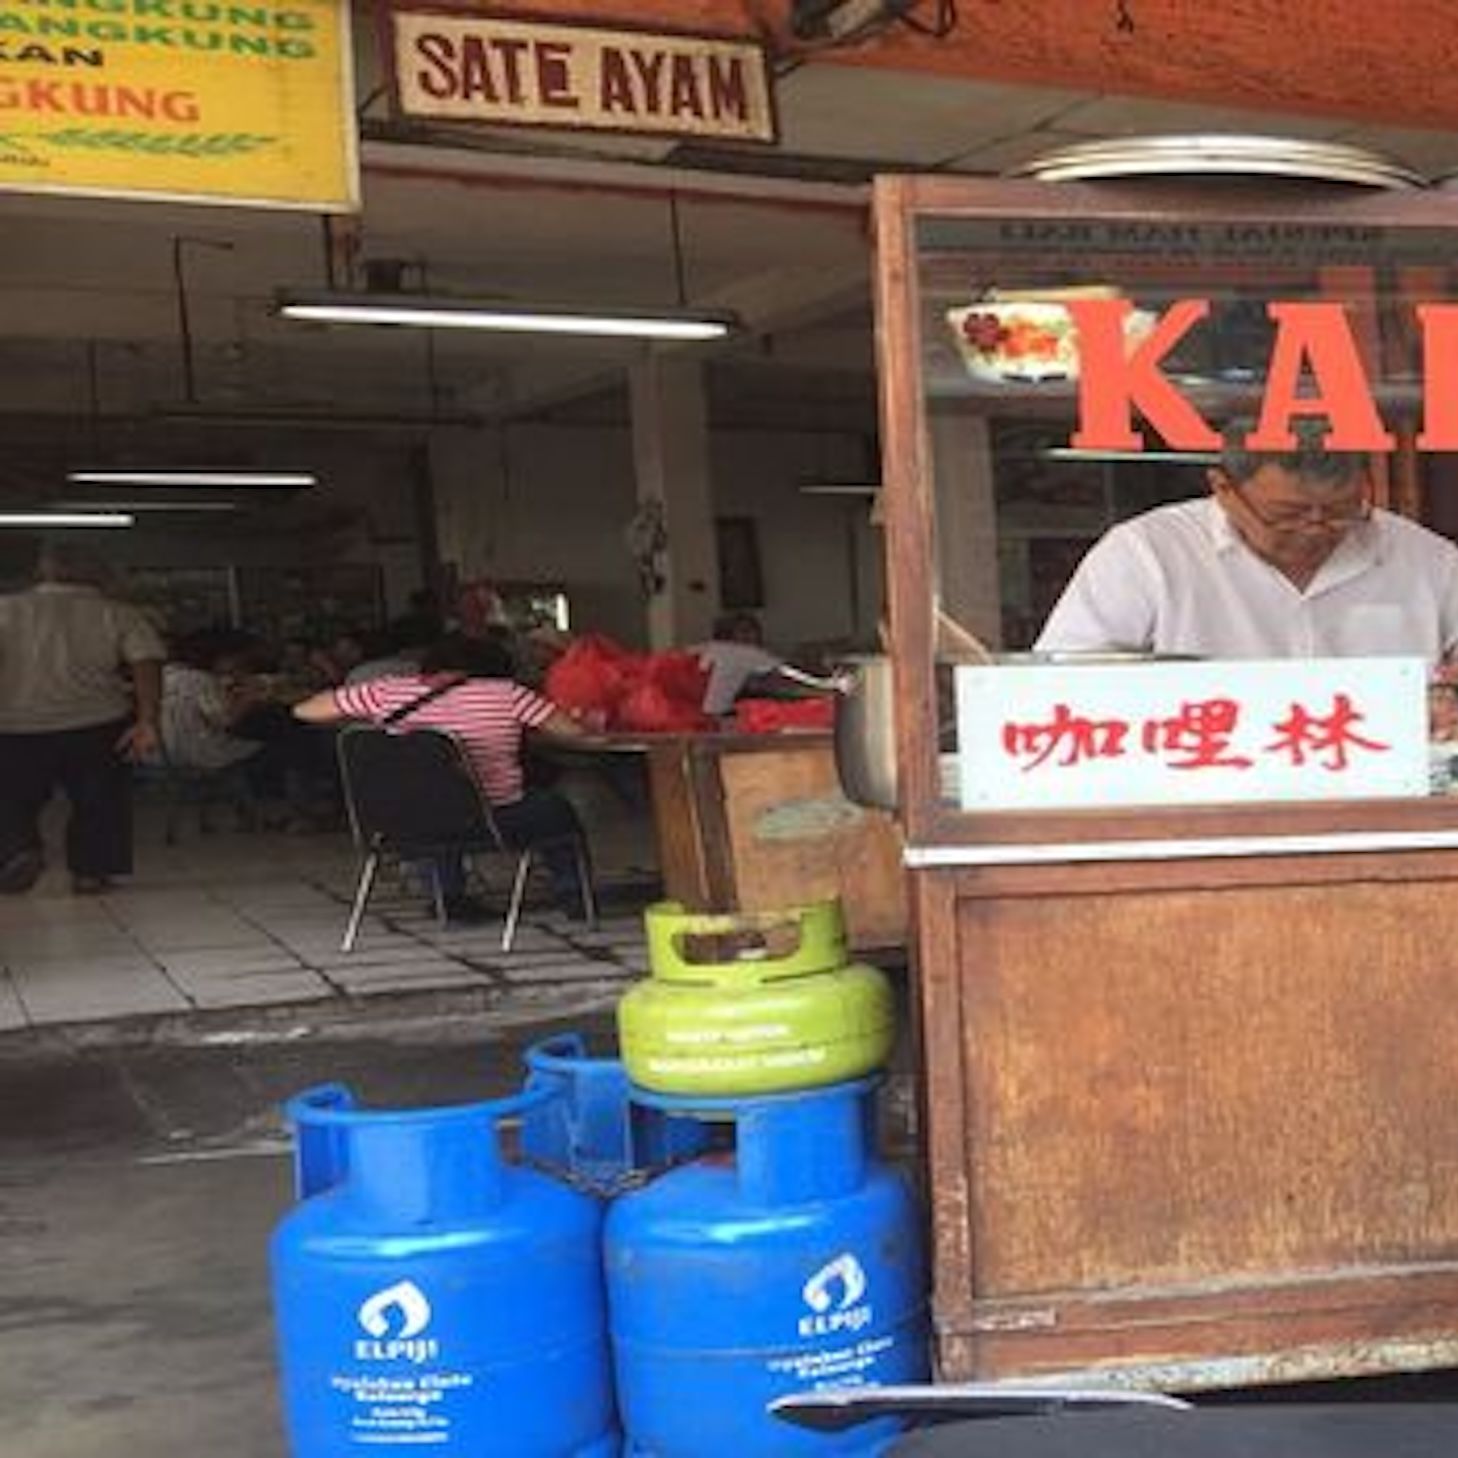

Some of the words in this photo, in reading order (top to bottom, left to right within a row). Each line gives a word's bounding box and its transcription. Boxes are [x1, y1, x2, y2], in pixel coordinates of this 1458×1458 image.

[0, 13, 315, 58] ANGKUNG
[20, 0, 315, 29] GKUNG
[416, 33, 578, 107] SATE
[601, 46, 747, 121] AYAM
